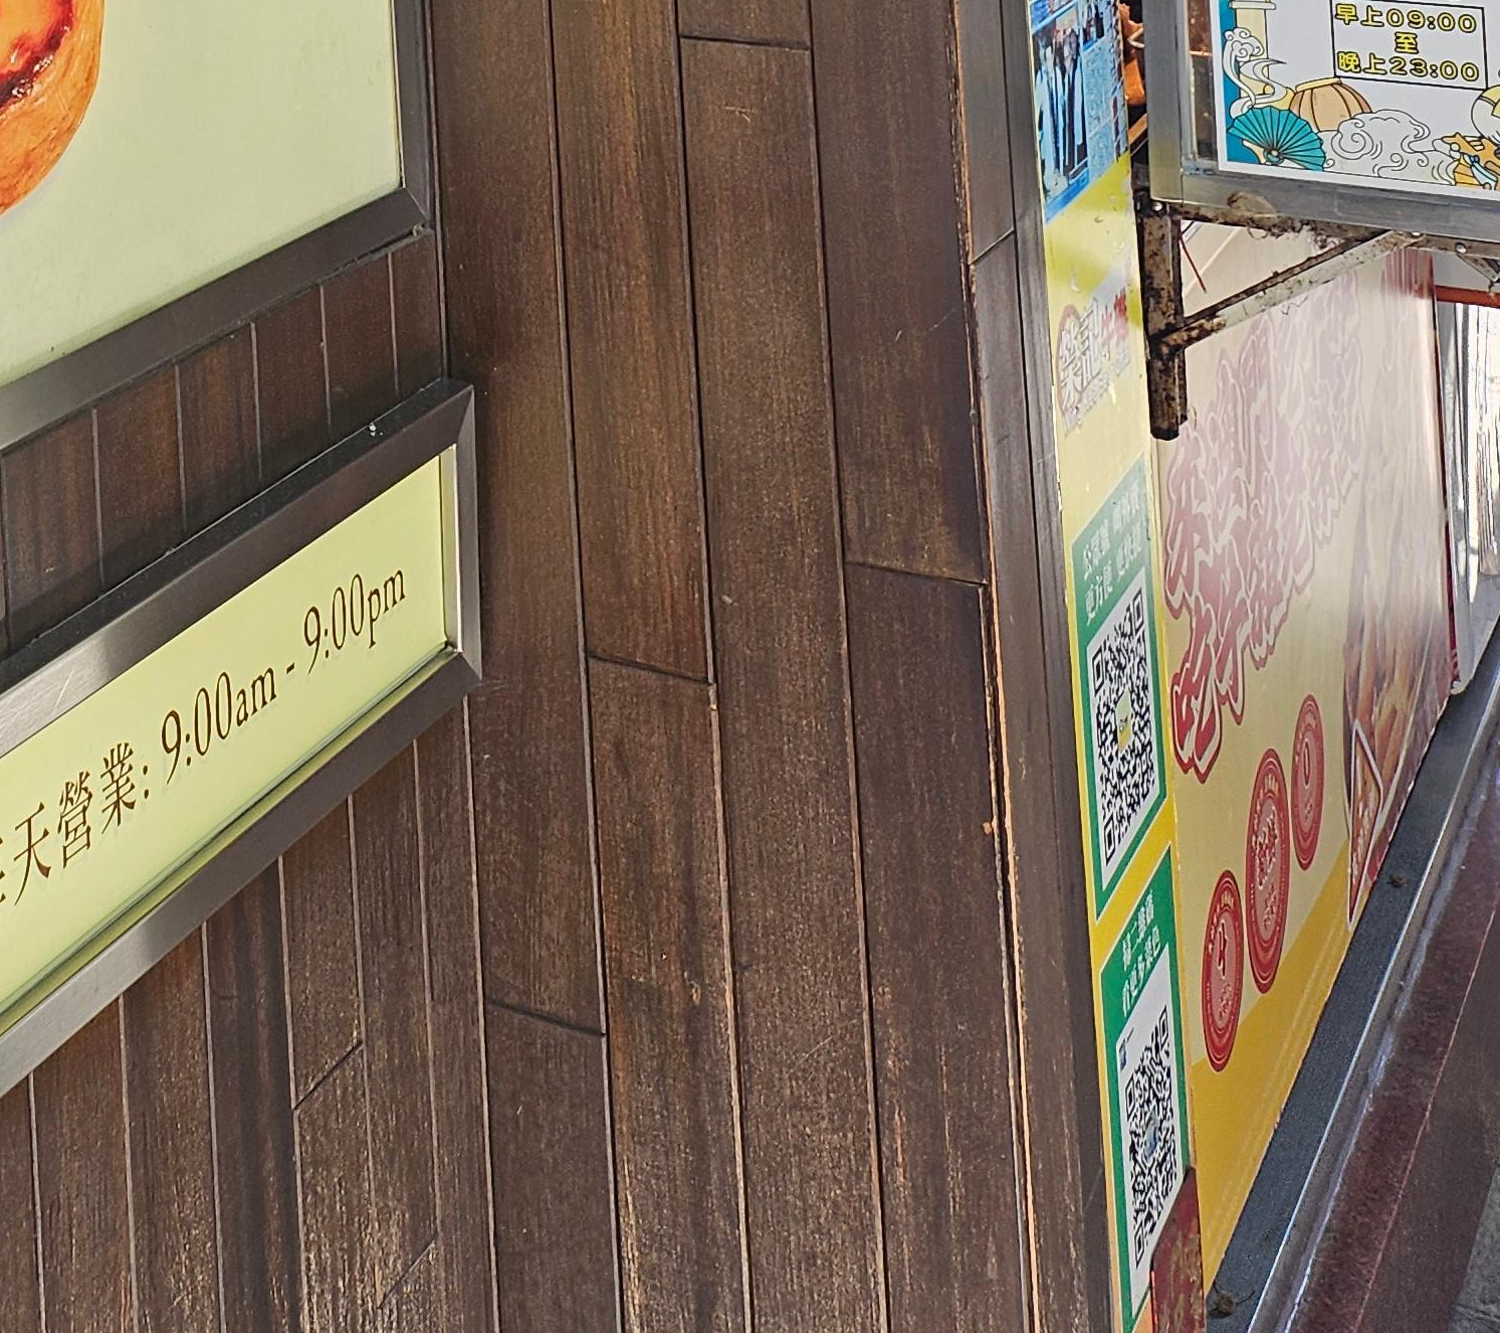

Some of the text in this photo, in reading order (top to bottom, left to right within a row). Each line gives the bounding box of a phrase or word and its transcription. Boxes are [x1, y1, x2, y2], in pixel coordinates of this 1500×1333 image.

[1334, 2, 1477, 34] 早上09:00
[1394, 30, 1420, 55] 至
[1336, 50, 1480, 82] 晚上23:00
[159, 659, 279, 786] 9:00am
[302, 563, 408, 676] 9:00pm
